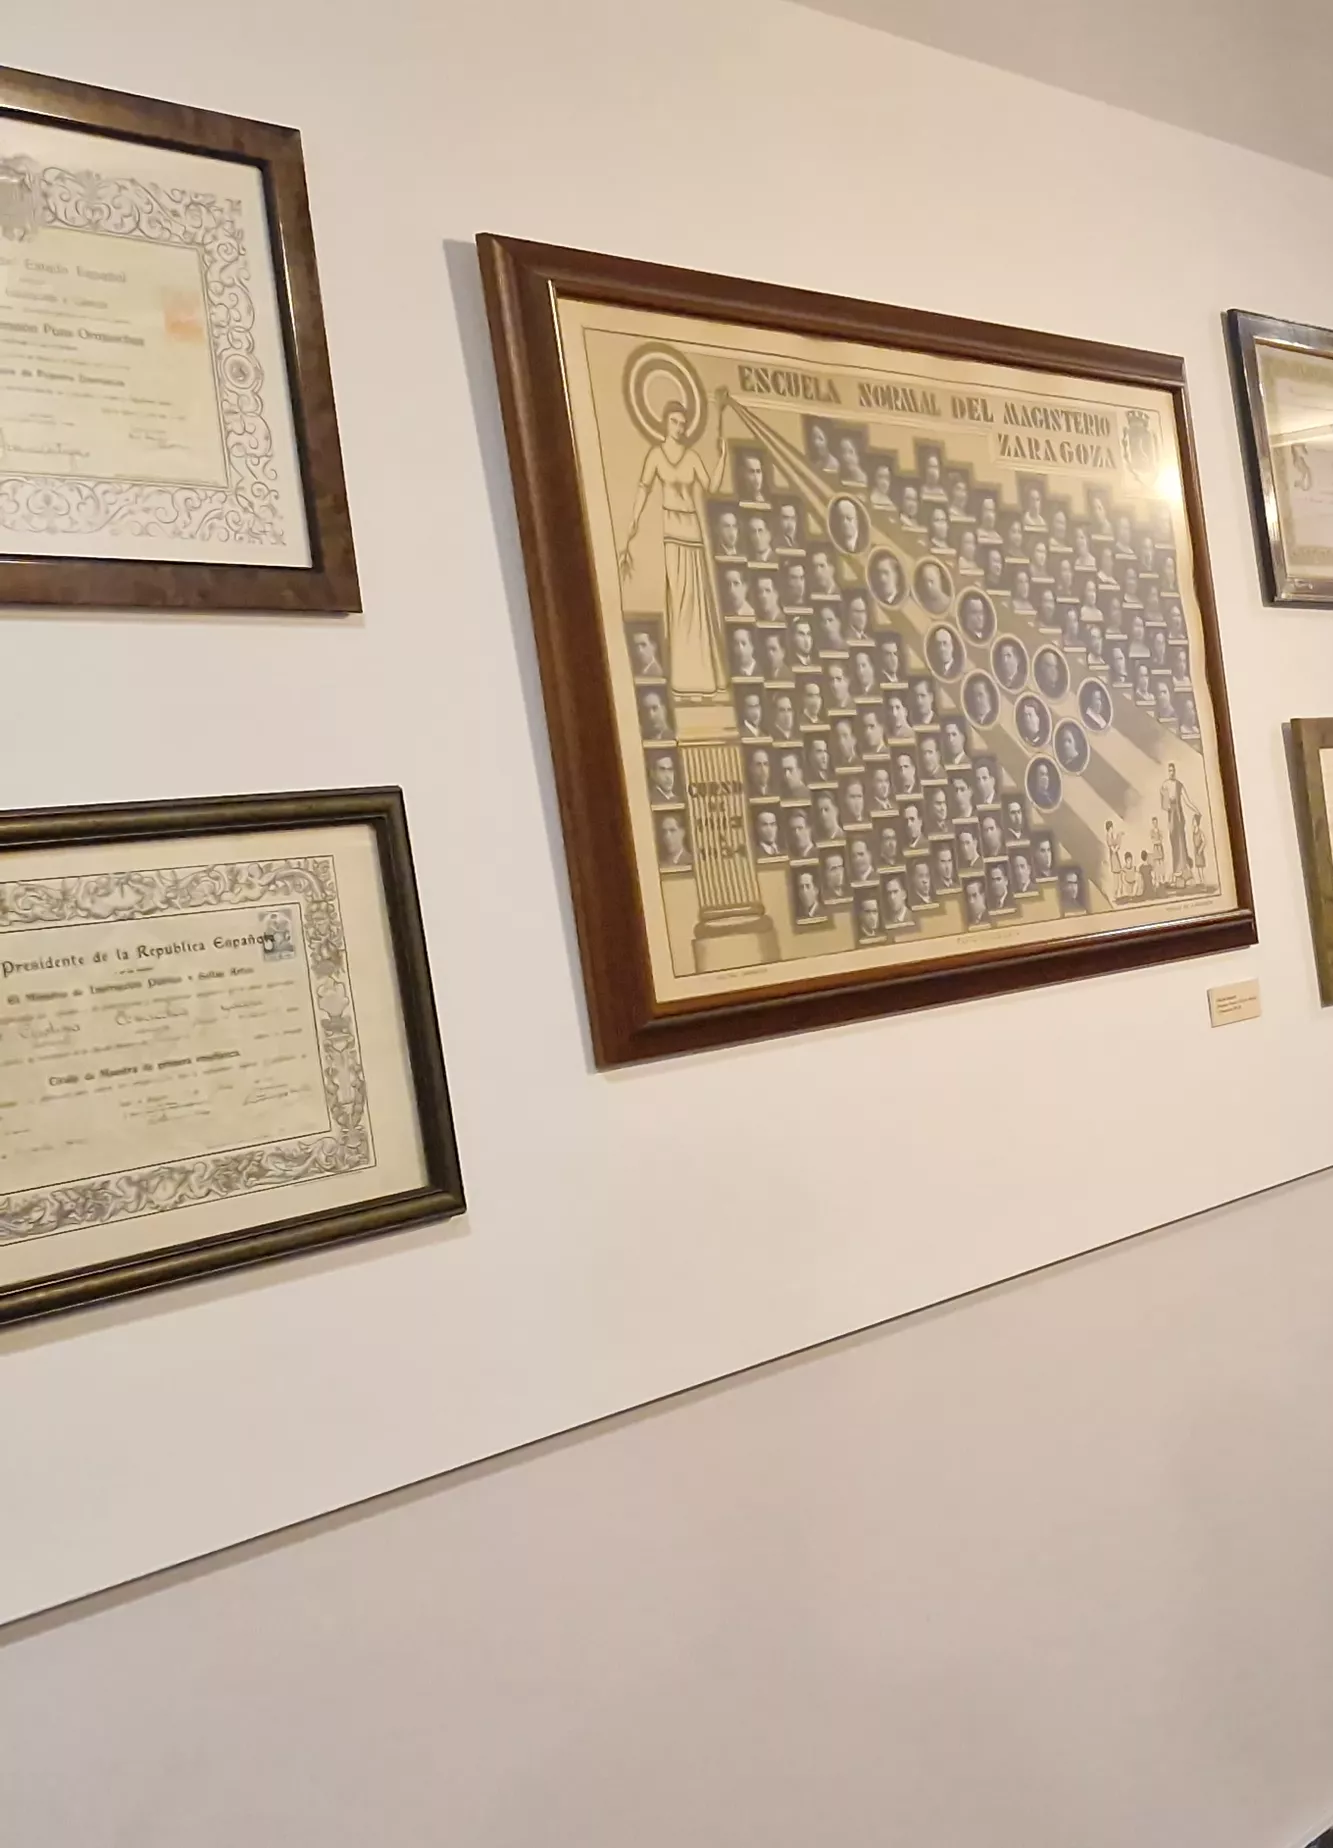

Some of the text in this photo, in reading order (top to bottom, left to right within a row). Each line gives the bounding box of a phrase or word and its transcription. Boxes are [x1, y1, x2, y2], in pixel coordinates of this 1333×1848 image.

[738, 365, 1110, 437] ESCUELA NORMAL DEL MAGISTERIO
[998, 433, 1116, 469] ZARAGOZA
[2, 955, 85, 978] Presidente
[93, 951, 108, 963] de
[116, 948, 129, 961] la
